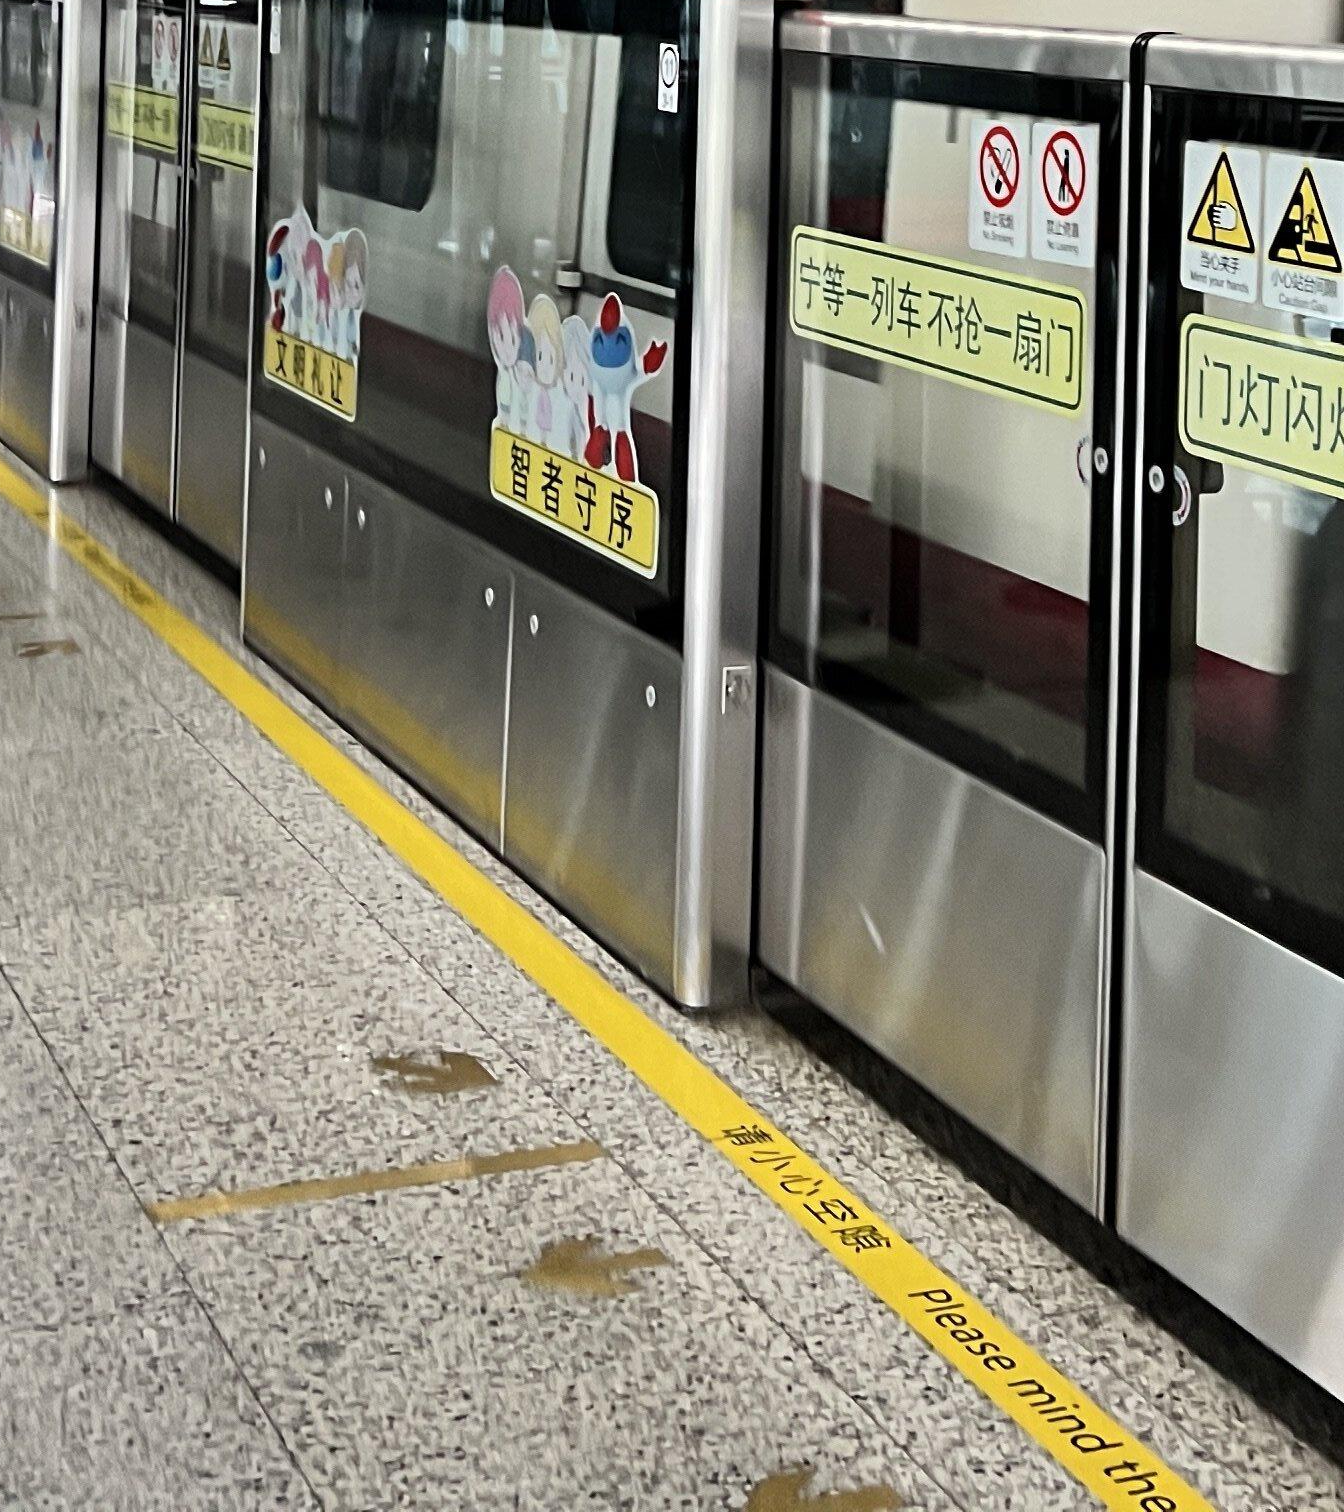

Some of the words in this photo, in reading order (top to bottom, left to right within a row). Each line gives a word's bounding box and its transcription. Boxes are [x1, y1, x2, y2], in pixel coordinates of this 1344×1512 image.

[799, 257, 1073, 382] 宁等一列车不抢一扇门
[511, 440, 633, 549] 智者守序
[722, 1124, 892, 1253] 请小心空隙
[907, 1288, 1017, 1371] Please
[1007, 1378, 1124, 1454] mind
[1103, 1460, 1177, 1512] the
